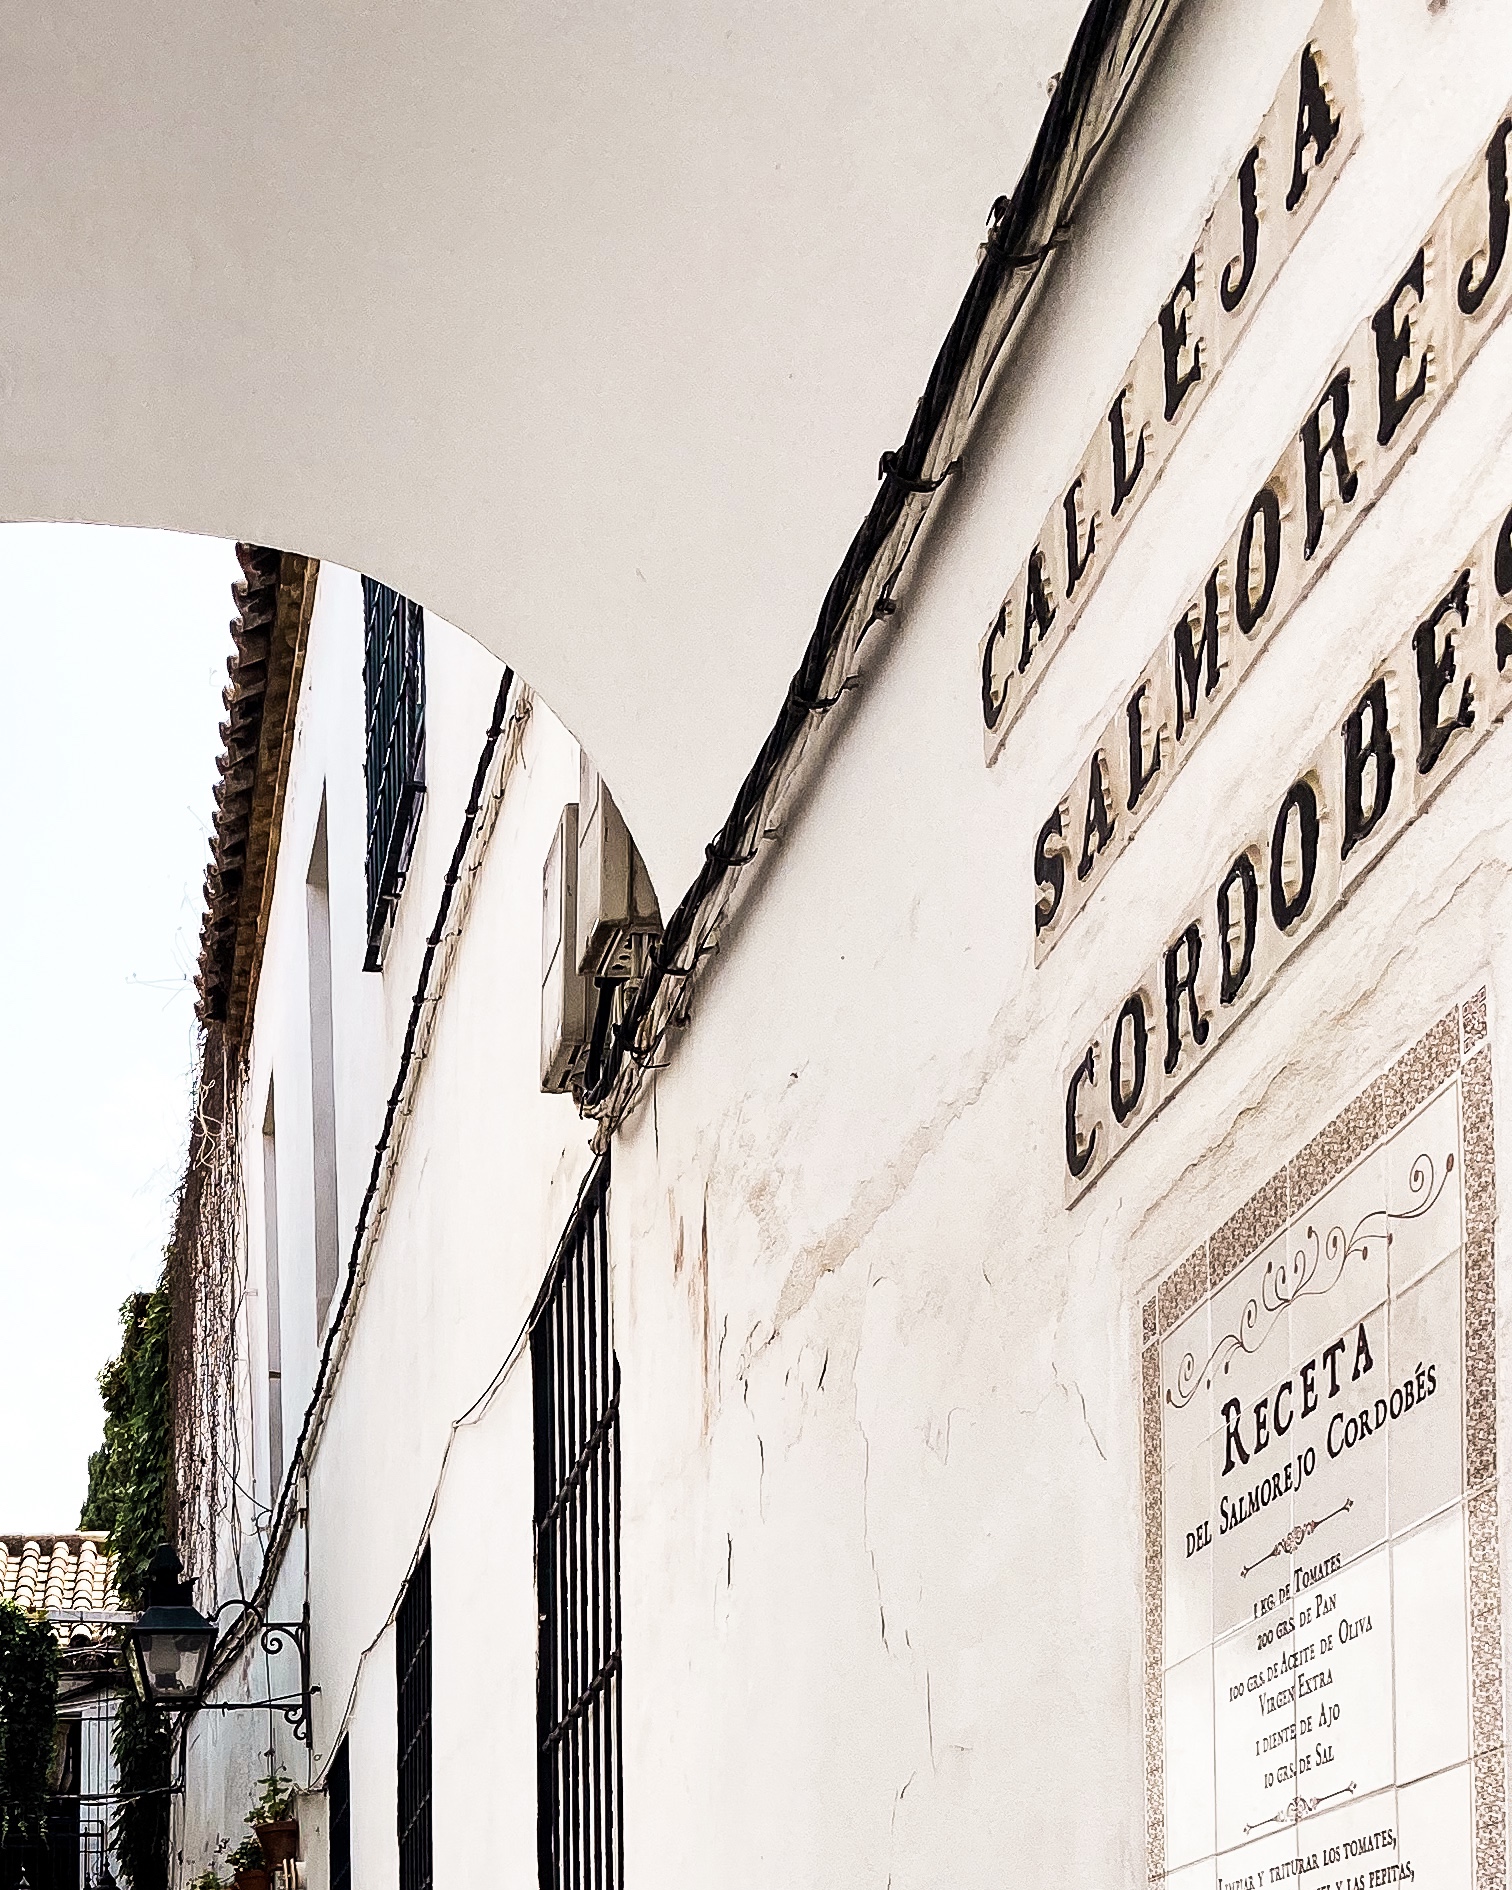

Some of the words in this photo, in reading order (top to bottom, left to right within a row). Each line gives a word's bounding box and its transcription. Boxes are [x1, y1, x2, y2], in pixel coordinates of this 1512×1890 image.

[981, 40, 1342, 731] CALLEJA
[1221, 1322, 1374, 1476] RECETA
[1186, 1521, 1212, 1558] DEL
[1220, 1447, 1316, 1535] SALMOREJO
[1327, 1361, 1437, 1459] CORDOBÉS
[1279, 1584, 1291, 1605] DE
[1294, 1553, 1341, 1593] TOMATES
[1300, 1607, 1312, 1628] DE
[1315, 1593, 1337, 1619] PAN
[1267, 1663, 1278, 1682] DE
[1281, 1643, 1315, 1674] ACEITE
[1320, 1634, 1334, 1655] DE
[1339, 1615, 1373, 1644] OLIVA
[1259, 1685, 1296, 1716] VIRGEN
[1298, 1668, 1333, 1698] EXTRA
[1263, 1723, 1297, 1753] DIENTE
[1300, 1716, 1313, 1735] DE
[1319, 1702, 1340, 1728] AJO
[1299, 1755, 1312, 1774] DE
[1316, 1742, 1334, 1767] SAL
[1257, 1870, 1264, 1887] Y
[1269, 1853, 1319, 1883] TRITURAR
[1323, 1846, 1341, 1866] LOS
[1343, 1829, 1396, 1859] TOMATES,
[1369, 1861, 1414, 1888] PEPITAS,
